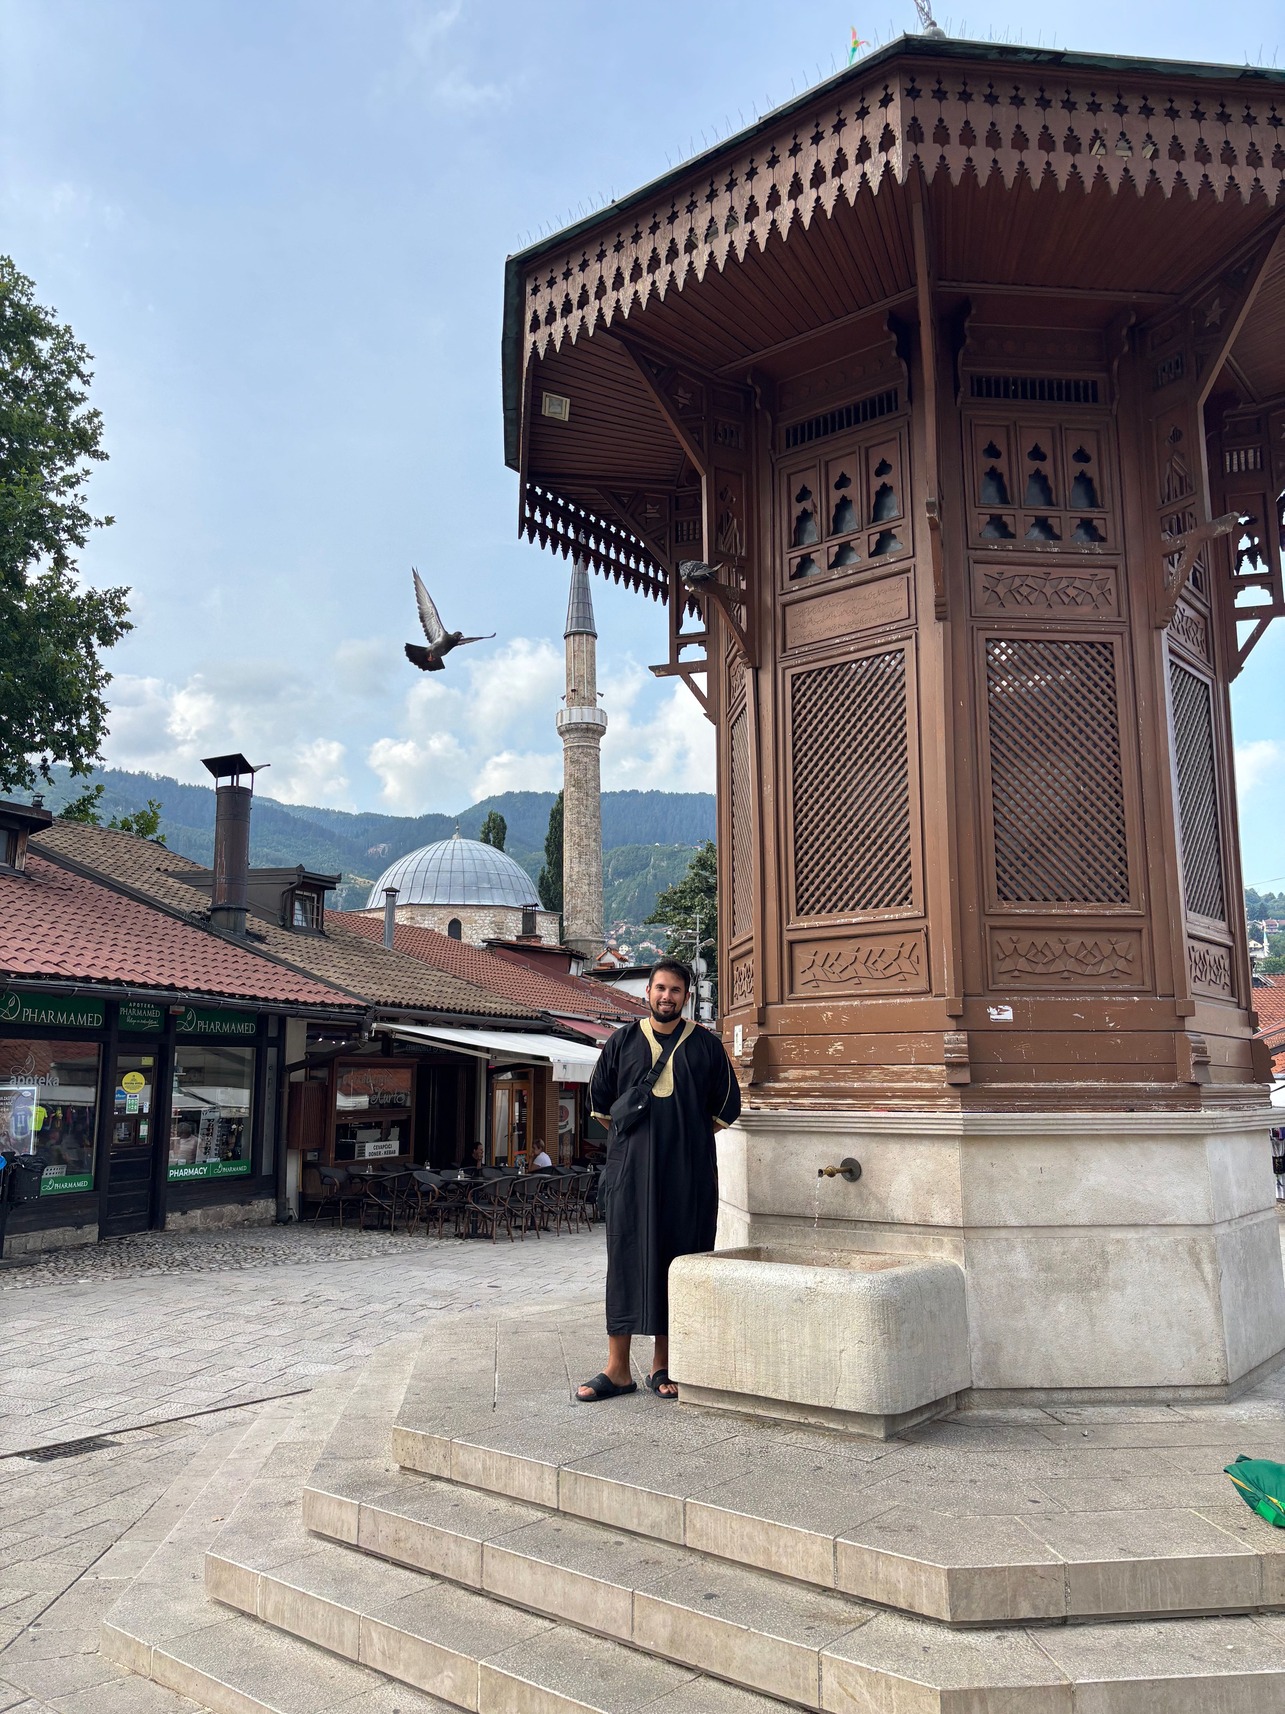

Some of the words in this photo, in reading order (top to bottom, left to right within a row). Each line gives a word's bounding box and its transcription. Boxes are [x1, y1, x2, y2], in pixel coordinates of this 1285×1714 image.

[22, 1008, 102, 1026] PHARMAMED
[120, 1007, 160, 1017] PHARMAMED
[197, 1020, 256, 1034] PHARMAMED
[9, 1073, 60, 1086] apoteka
[169, 1167, 208, 1178] PHARMACY
[54, 1180, 88, 1190] PHARMAMED
